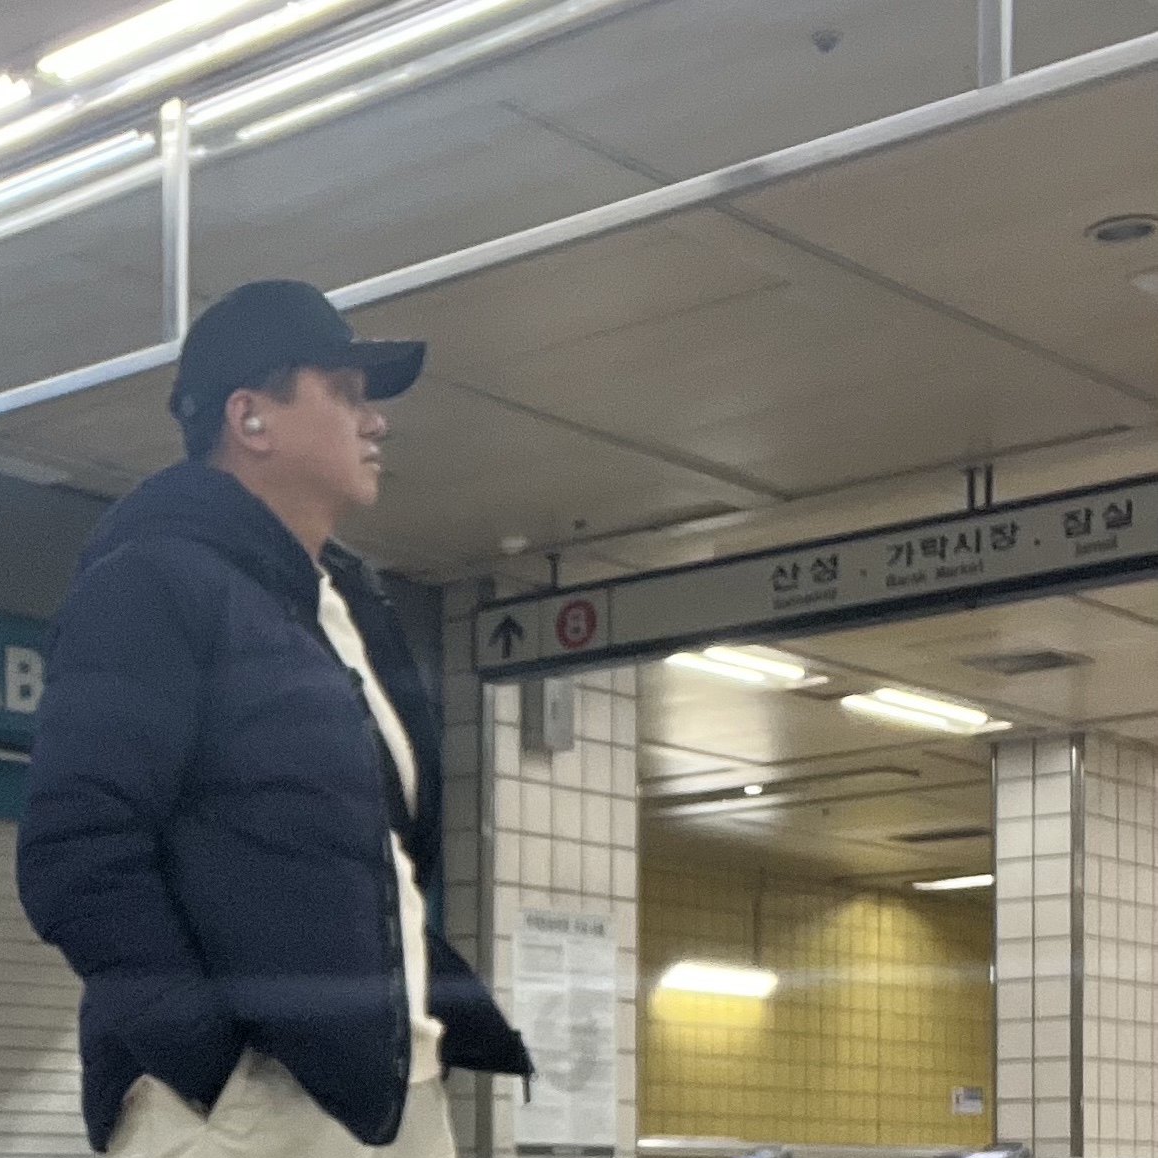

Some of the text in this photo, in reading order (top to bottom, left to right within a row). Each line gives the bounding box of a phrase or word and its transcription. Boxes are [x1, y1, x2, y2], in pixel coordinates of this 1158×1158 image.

[770, 499, 1133, 592] 산성 가락시장 잠실
